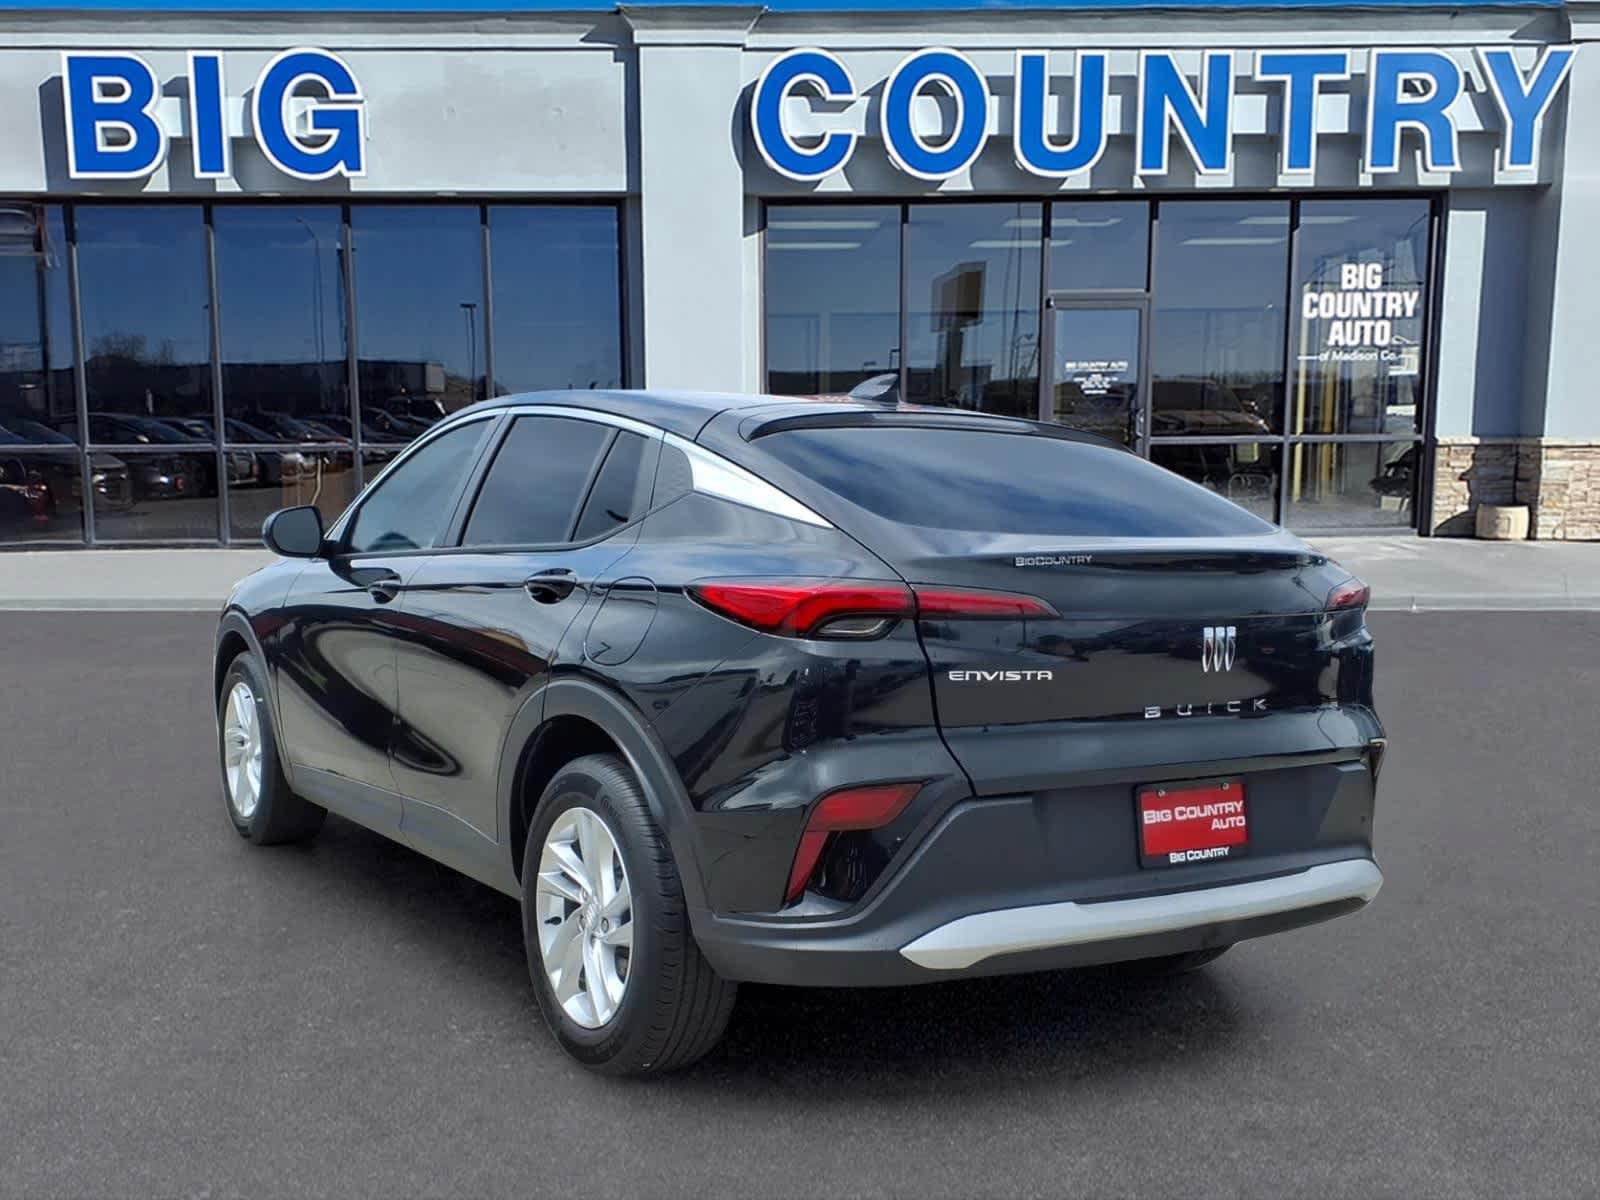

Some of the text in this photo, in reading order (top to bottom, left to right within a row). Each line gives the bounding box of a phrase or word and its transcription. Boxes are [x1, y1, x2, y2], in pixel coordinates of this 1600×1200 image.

[61, 46, 1576, 181] BIG COUNTRY
[1341, 263, 1383, 290] BIG
[1302, 291, 1420, 319] COUNTRY
[1327, 320, 1392, 347] AUTO
[948, 670, 1053, 682] ENVISTA
[1144, 697, 1267, 720] BUICK
[1211, 815, 1246, 830] AUTO
